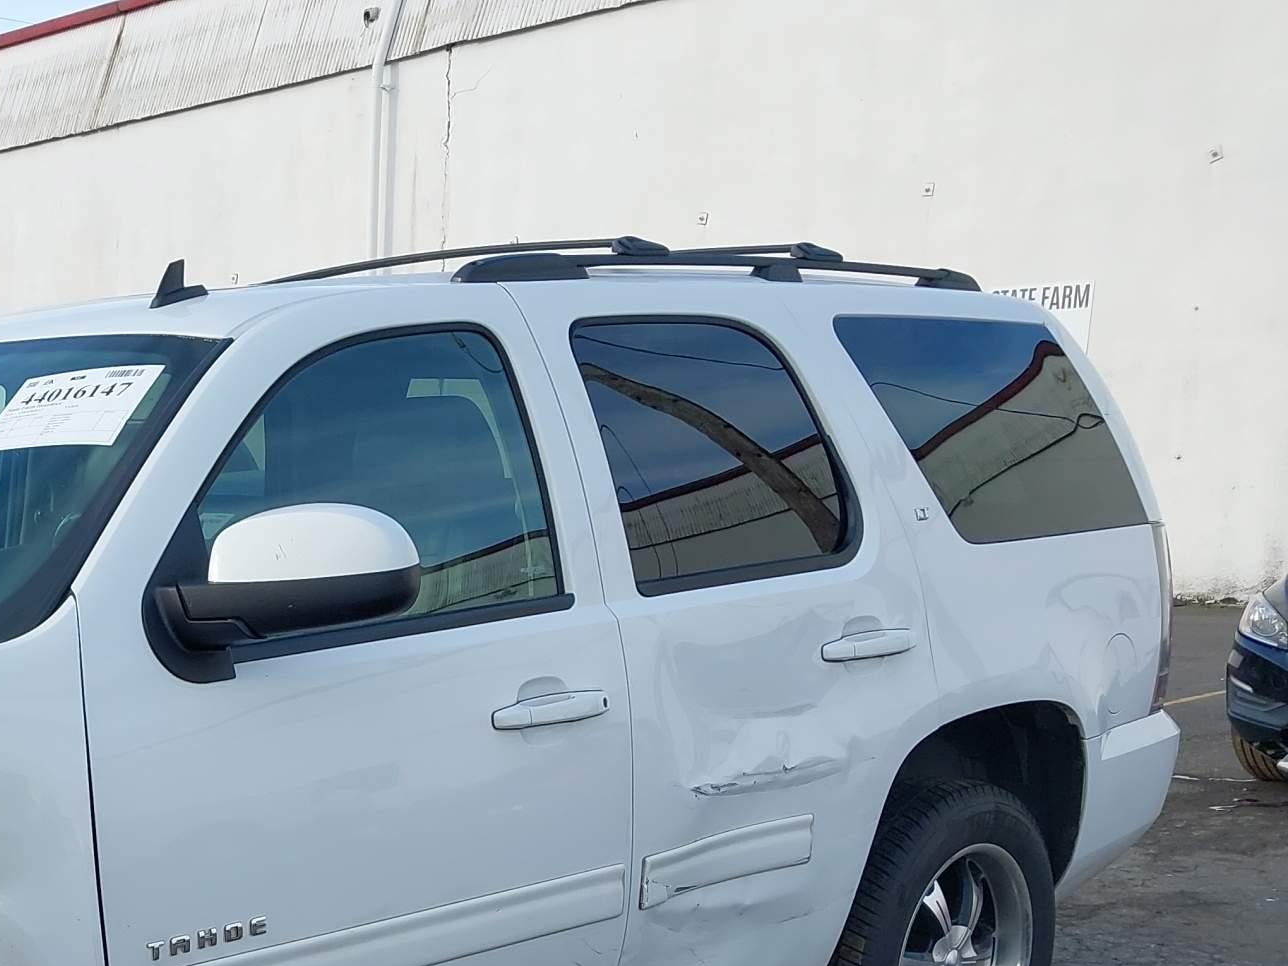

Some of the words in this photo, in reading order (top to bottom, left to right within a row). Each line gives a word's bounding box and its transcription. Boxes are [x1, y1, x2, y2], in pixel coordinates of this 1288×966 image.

[1041, 283, 1091, 310] FARM
[20, 382, 133, 405] 44016147
[146, 916, 267, 961] TAHOE
